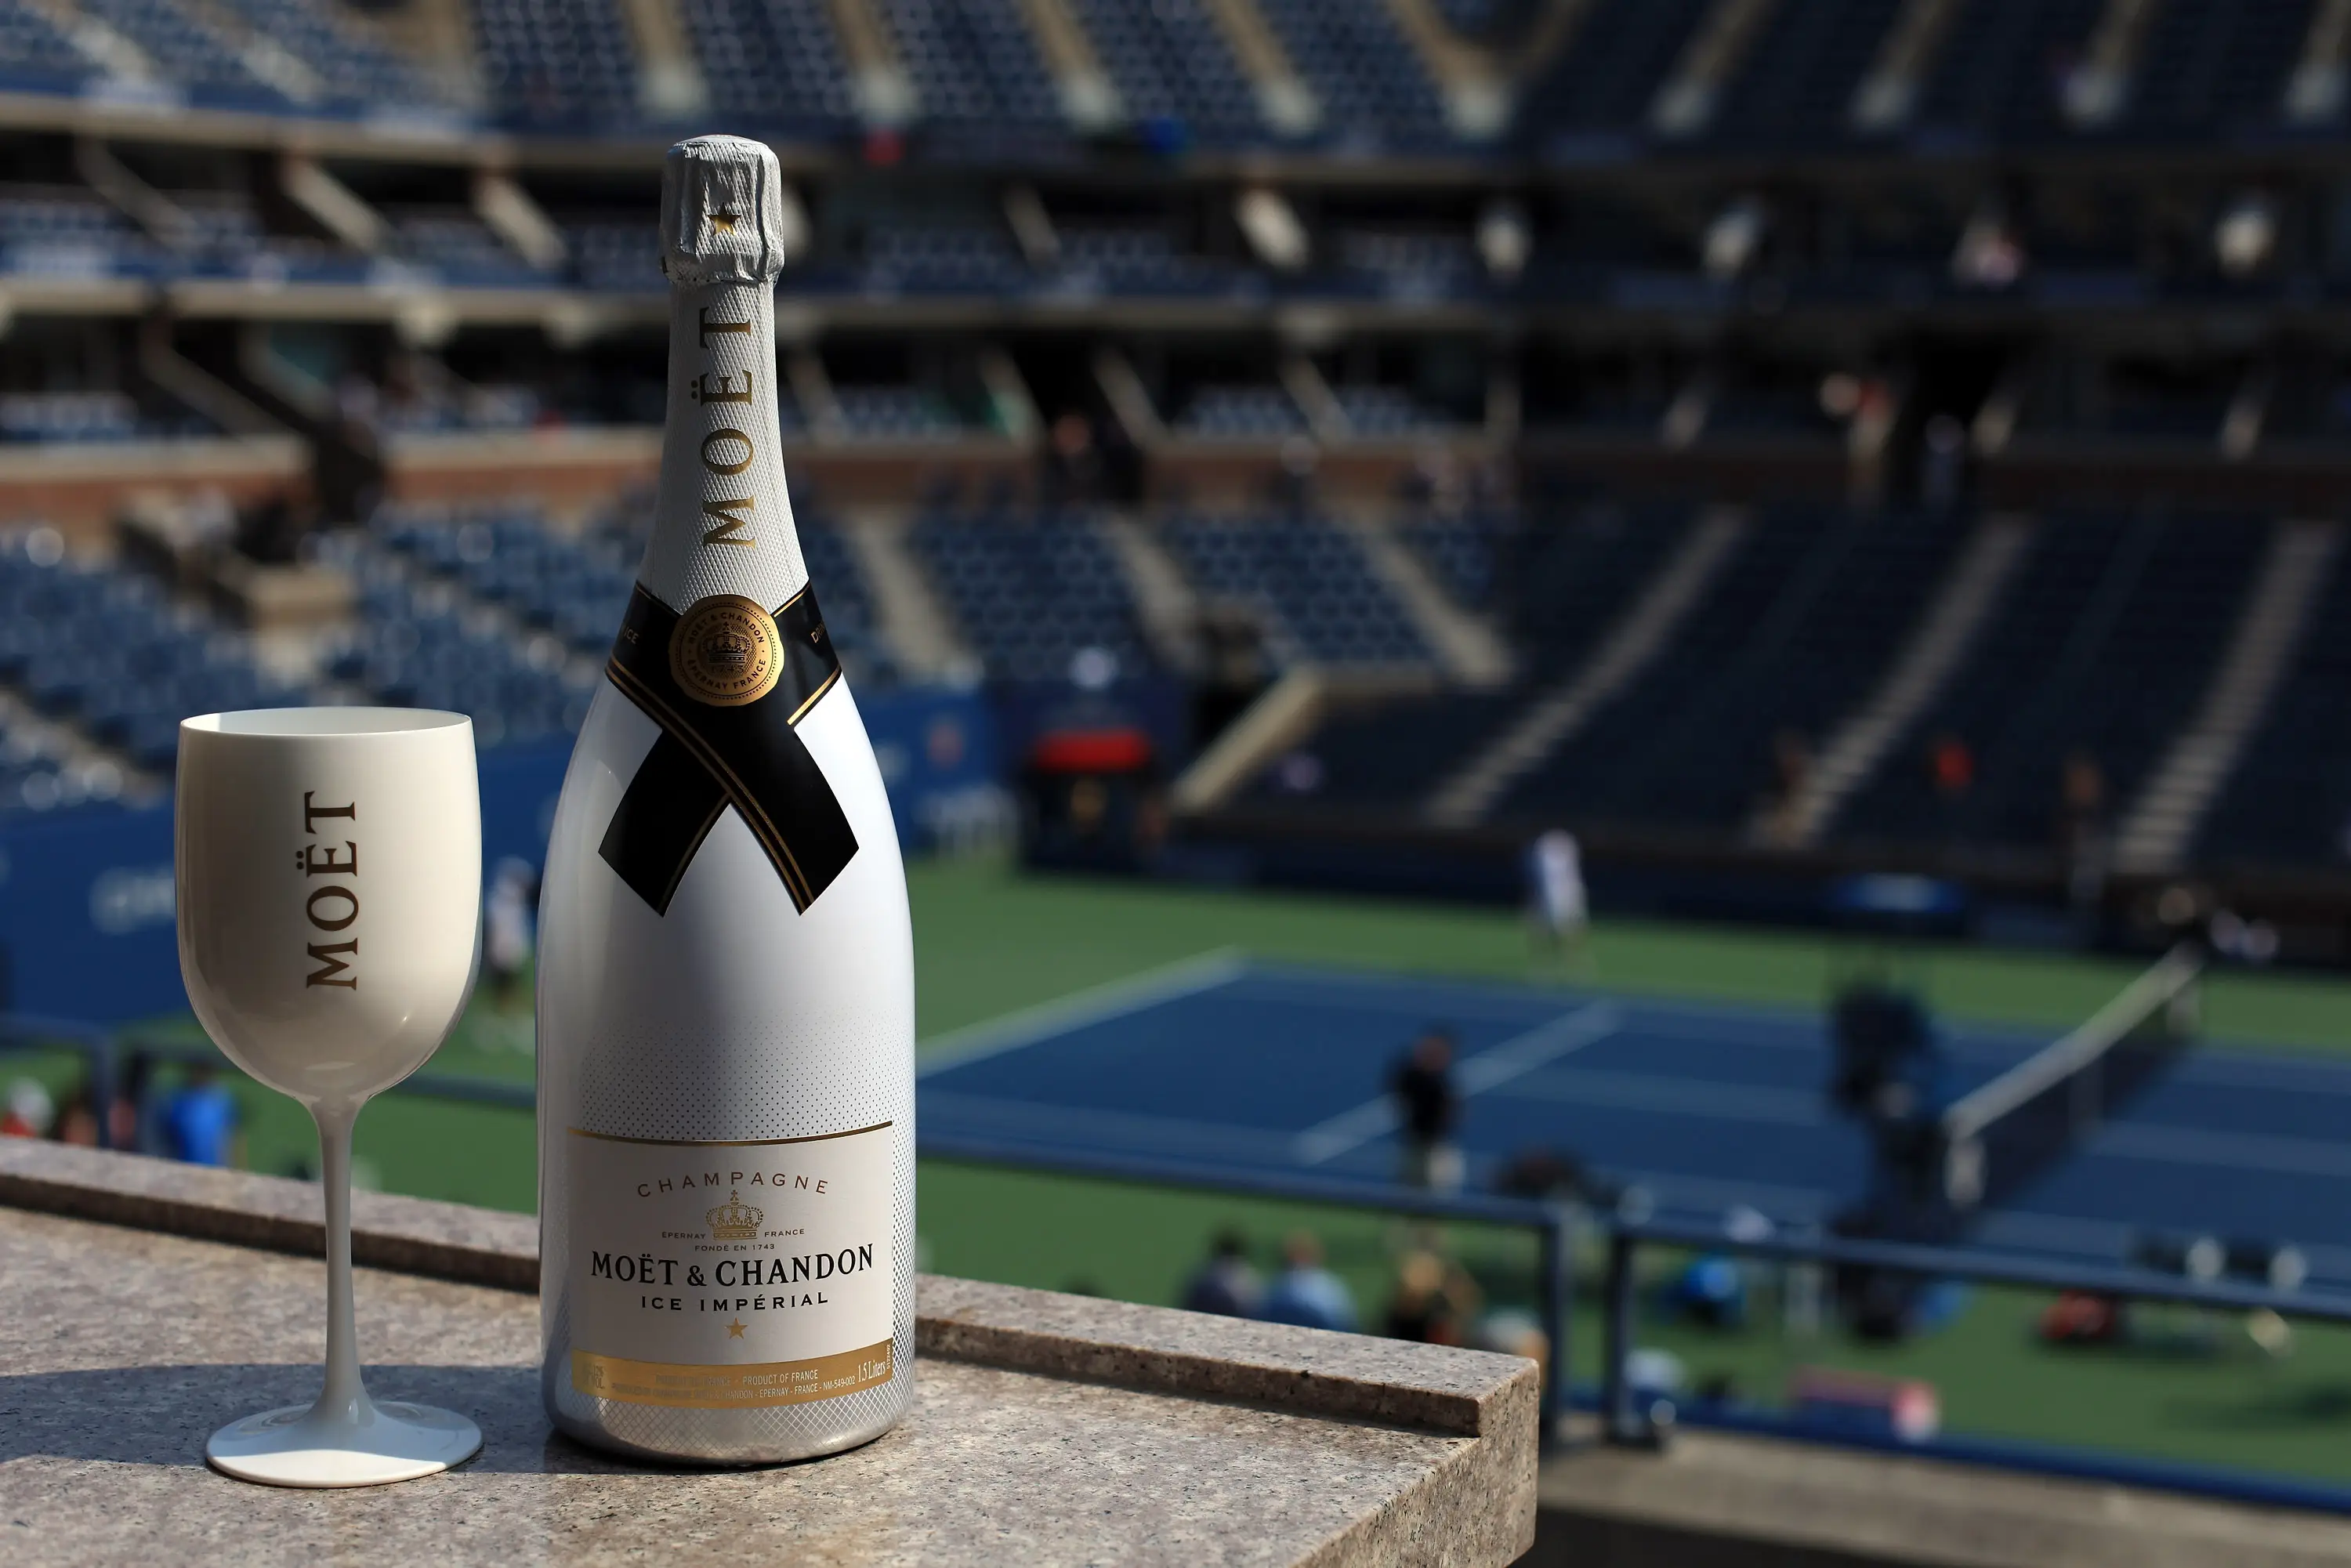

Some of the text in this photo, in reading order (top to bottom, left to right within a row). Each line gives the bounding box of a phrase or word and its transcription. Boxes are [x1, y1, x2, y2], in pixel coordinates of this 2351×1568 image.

[691, 306, 756, 549] MOËT
[720, 612, 765, 643] CHANDON
[734, 659, 766, 689] FRANCE
[296, 790, 359, 990] MOËT
[637, 1171, 828, 1197] CHAMPAGNE
[764, 1228, 805, 1238] FRANCE
[752, 1243, 775, 1251] 1743
[592, 1243, 874, 1287] MOËT & CHANDON
[641, 1291, 829, 1313] ICE IMPÉRIAL
[742, 1374, 777, 1387] PRODUCT
[780, 1372, 789, 1384] OF
[792, 1369, 819, 1383] FRANCE
[868, 1360, 886, 1380] Liters
[759, 1386, 789, 1399] EPERNAY
[794, 1382, 819, 1396] FRANCE
[823, 1375, 856, 1391] NM-549-002
